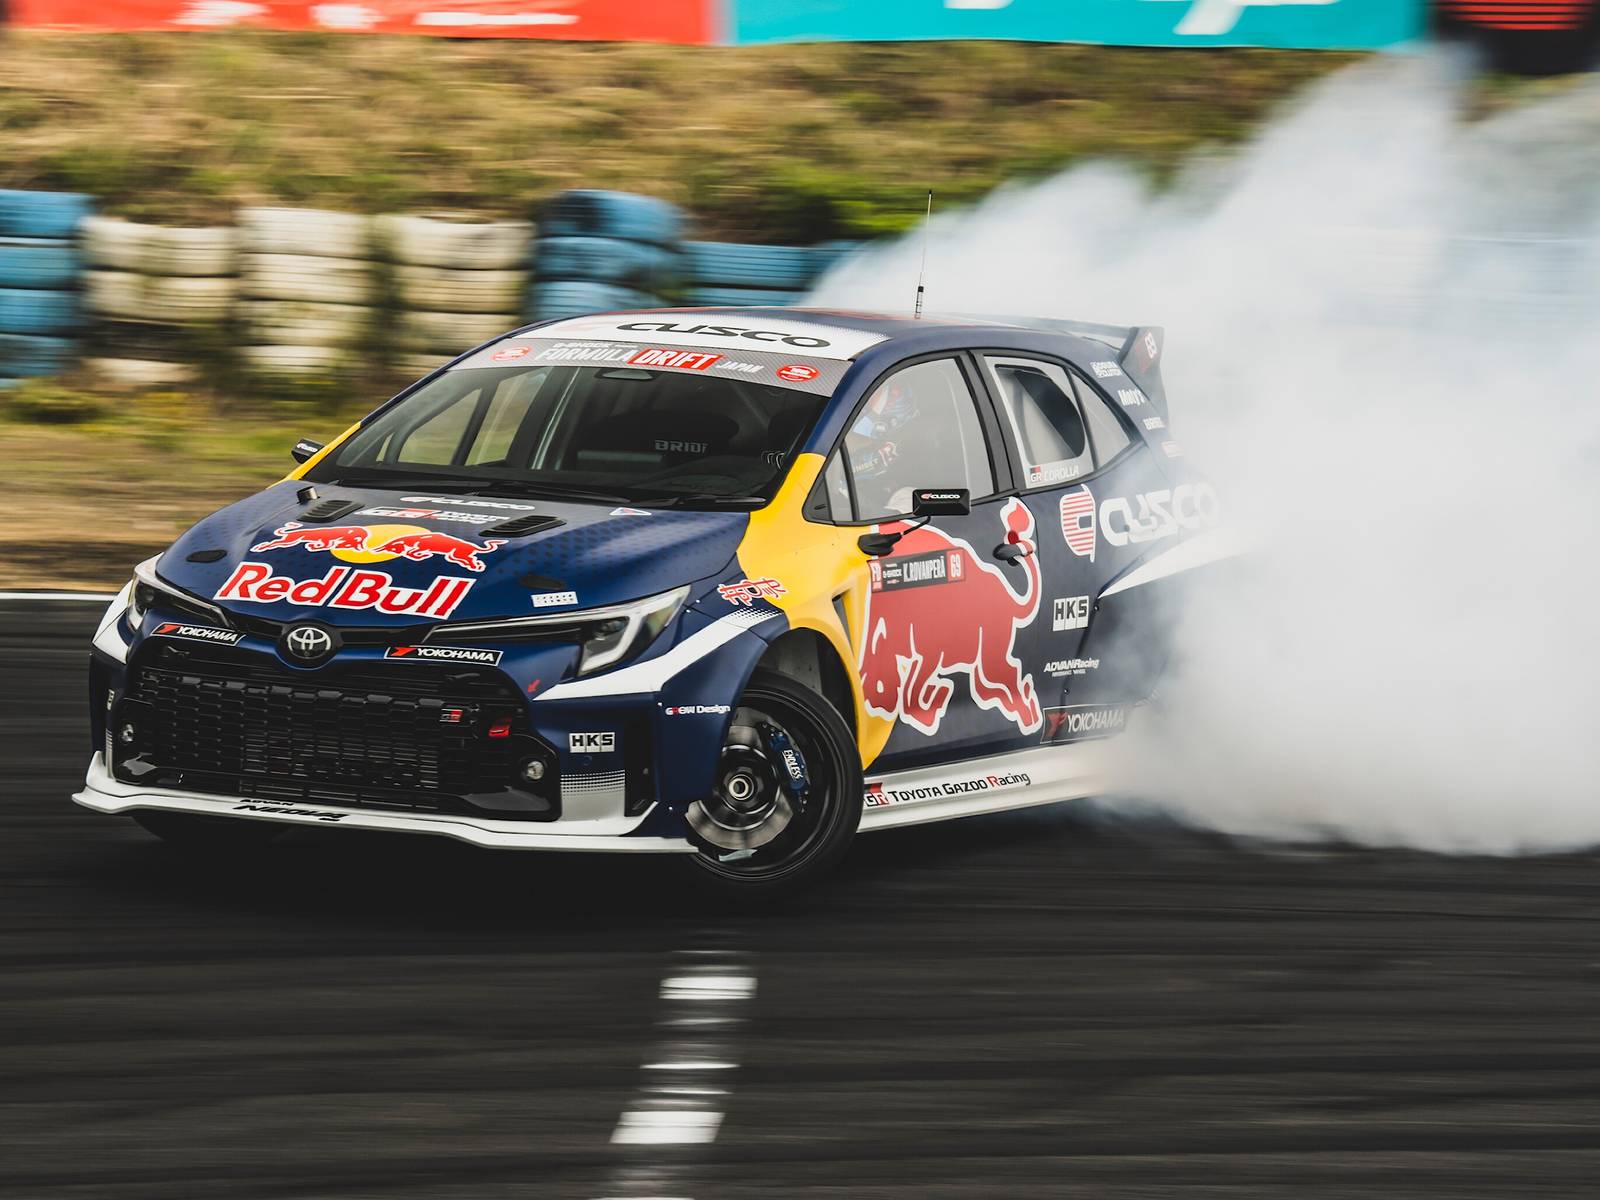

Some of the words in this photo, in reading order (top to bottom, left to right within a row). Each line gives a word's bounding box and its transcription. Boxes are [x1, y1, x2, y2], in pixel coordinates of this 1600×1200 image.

[617, 322, 831, 348] CUSCO
[534, 348, 637, 362] FORMULA
[633, 350, 719, 369] DRIFT
[716, 360, 764, 374] JAPAN
[1030, 473, 1042, 482] GR
[1044, 465, 1079, 481] COROLLA
[1099, 482, 1218, 546] CUSCO
[950, 554, 962, 578] 69
[216, 562, 347, 606] Red
[331, 570, 473, 618] Bull
[1055, 599, 1088, 621] HKS
[177, 626, 238, 642] YOKOHAMA
[417, 648, 495, 661] YOKOHAMA
[696, 704, 731, 714] Design
[1067, 709, 1124, 732] YOKOHAMA
[571, 733, 614, 747] HKS
[783, 749, 803, 780] ENDLESS
[864, 793, 889, 807] GR
[888, 787, 943, 802] TOYOTA
[942, 779, 988, 795] GAZOO
[986, 772, 1031, 788] Racing
